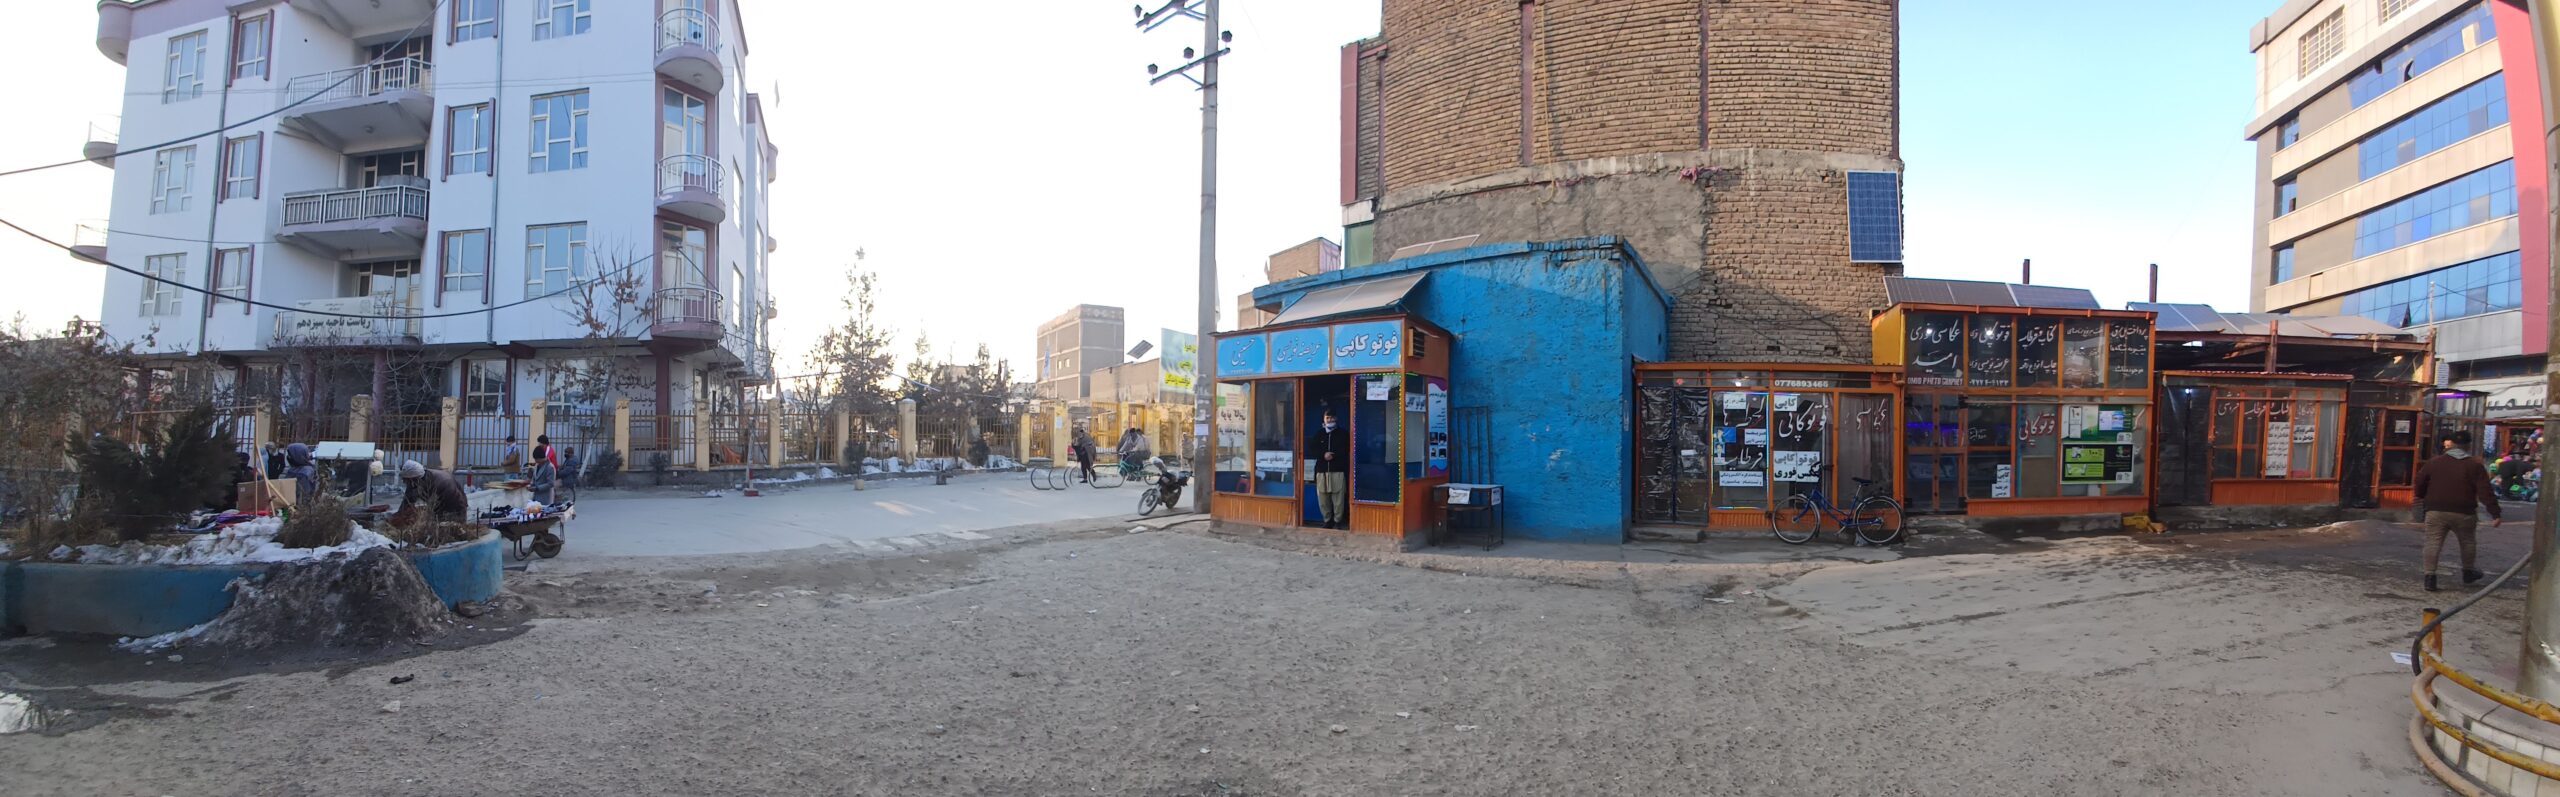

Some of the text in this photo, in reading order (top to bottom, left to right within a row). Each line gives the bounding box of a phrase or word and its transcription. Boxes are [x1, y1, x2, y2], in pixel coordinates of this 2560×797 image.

[297, 315, 371, 330] ریاست ناحیه سیزدهم
[1335, 331, 1398, 357] فوتو کاپی
[1912, 350, 1958, 373] امید
[1774, 467, 1797, 479] فوری
